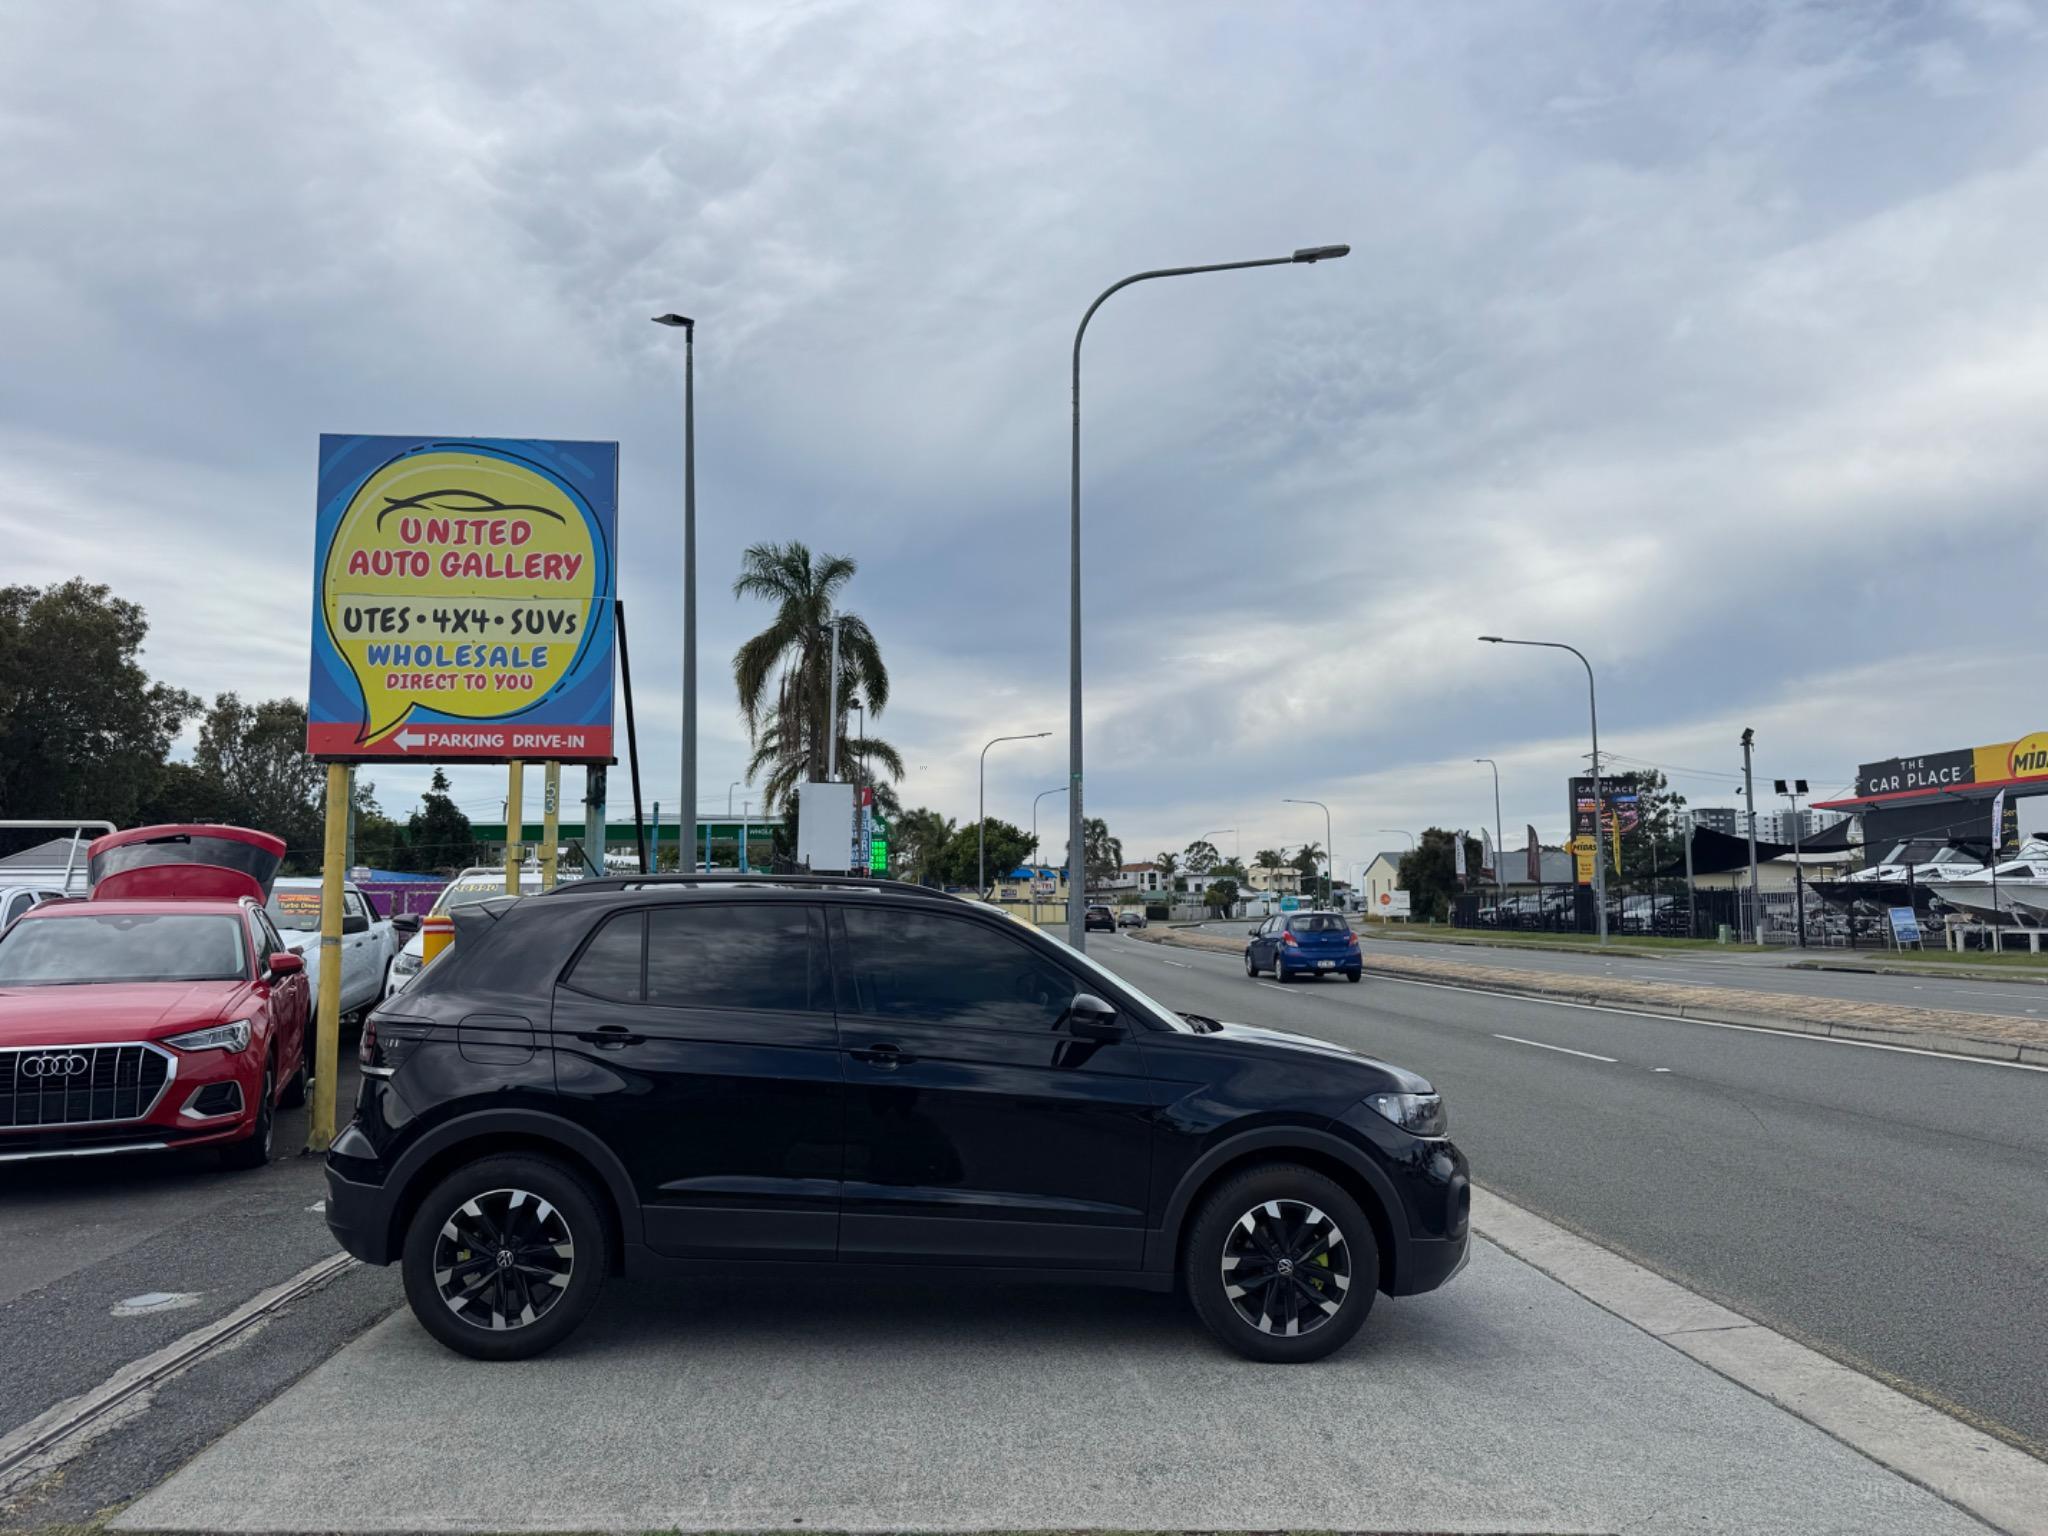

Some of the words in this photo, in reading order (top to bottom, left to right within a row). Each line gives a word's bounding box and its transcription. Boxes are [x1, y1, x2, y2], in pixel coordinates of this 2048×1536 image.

[400, 518, 531, 545] UNITED
[348, 549, 430, 578] AUTO
[440, 551, 582, 581] GALLERY
[343, 607, 411, 634] UTES
[432, 608, 489, 634] 4X4
[511, 608, 577, 635] SUVs
[367, 644, 548, 668] WHOLESALE
[386, 673, 459, 690] DIRECT
[463, 674, 487, 690] TO
[494, 674, 533, 690] YOU
[428, 733, 505, 748] PARKING
[512, 734, 585, 749] DRIVE-IN
[1901, 758, 1925, 771] THE
[2013, 743, 2048, 771] MID
[1869, 775, 1900, 793] CAR
[1907, 766, 1961, 788] PLACE
